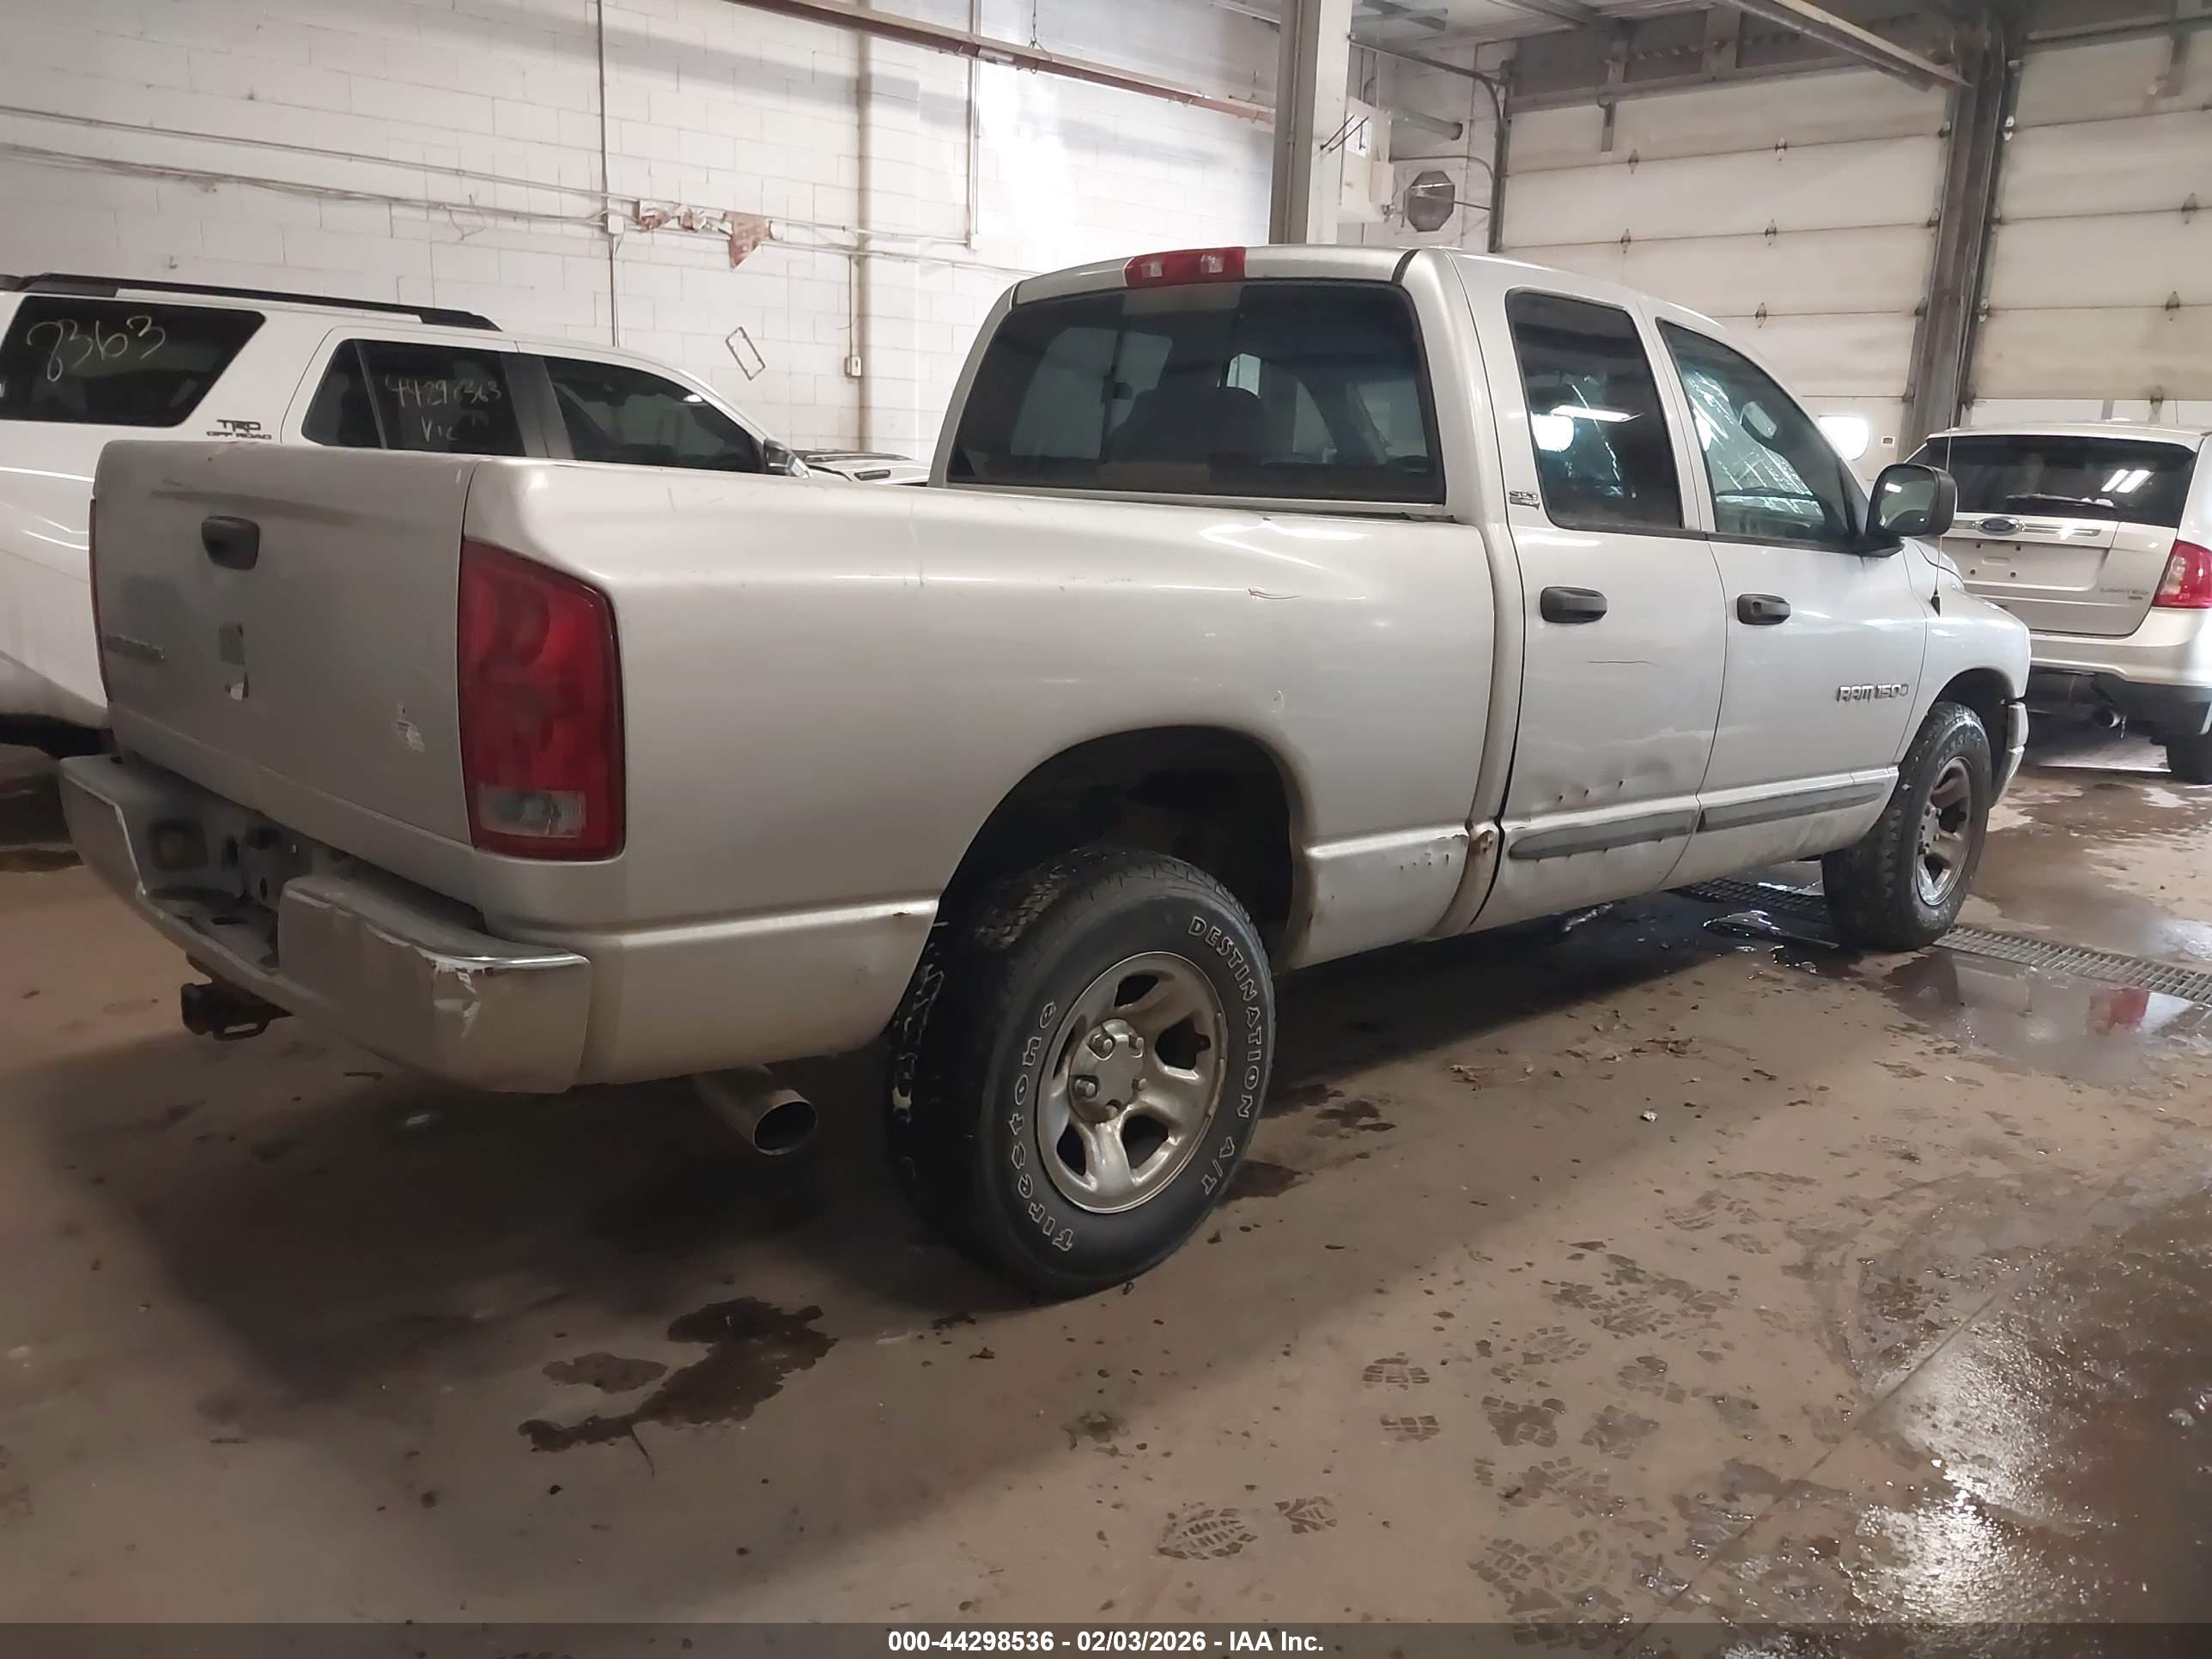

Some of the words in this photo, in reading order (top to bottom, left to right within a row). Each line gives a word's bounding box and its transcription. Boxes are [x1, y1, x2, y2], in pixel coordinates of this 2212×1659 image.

[27, 314, 166, 382] 8363
[216, 419, 261, 433] TRD
[1836, 684, 1874, 703] RAM
[1875, 684, 1909, 699] 1500
[1188, 915, 1263, 1119] DESTINATION
[1202, 1136, 1236, 1195] A/T
